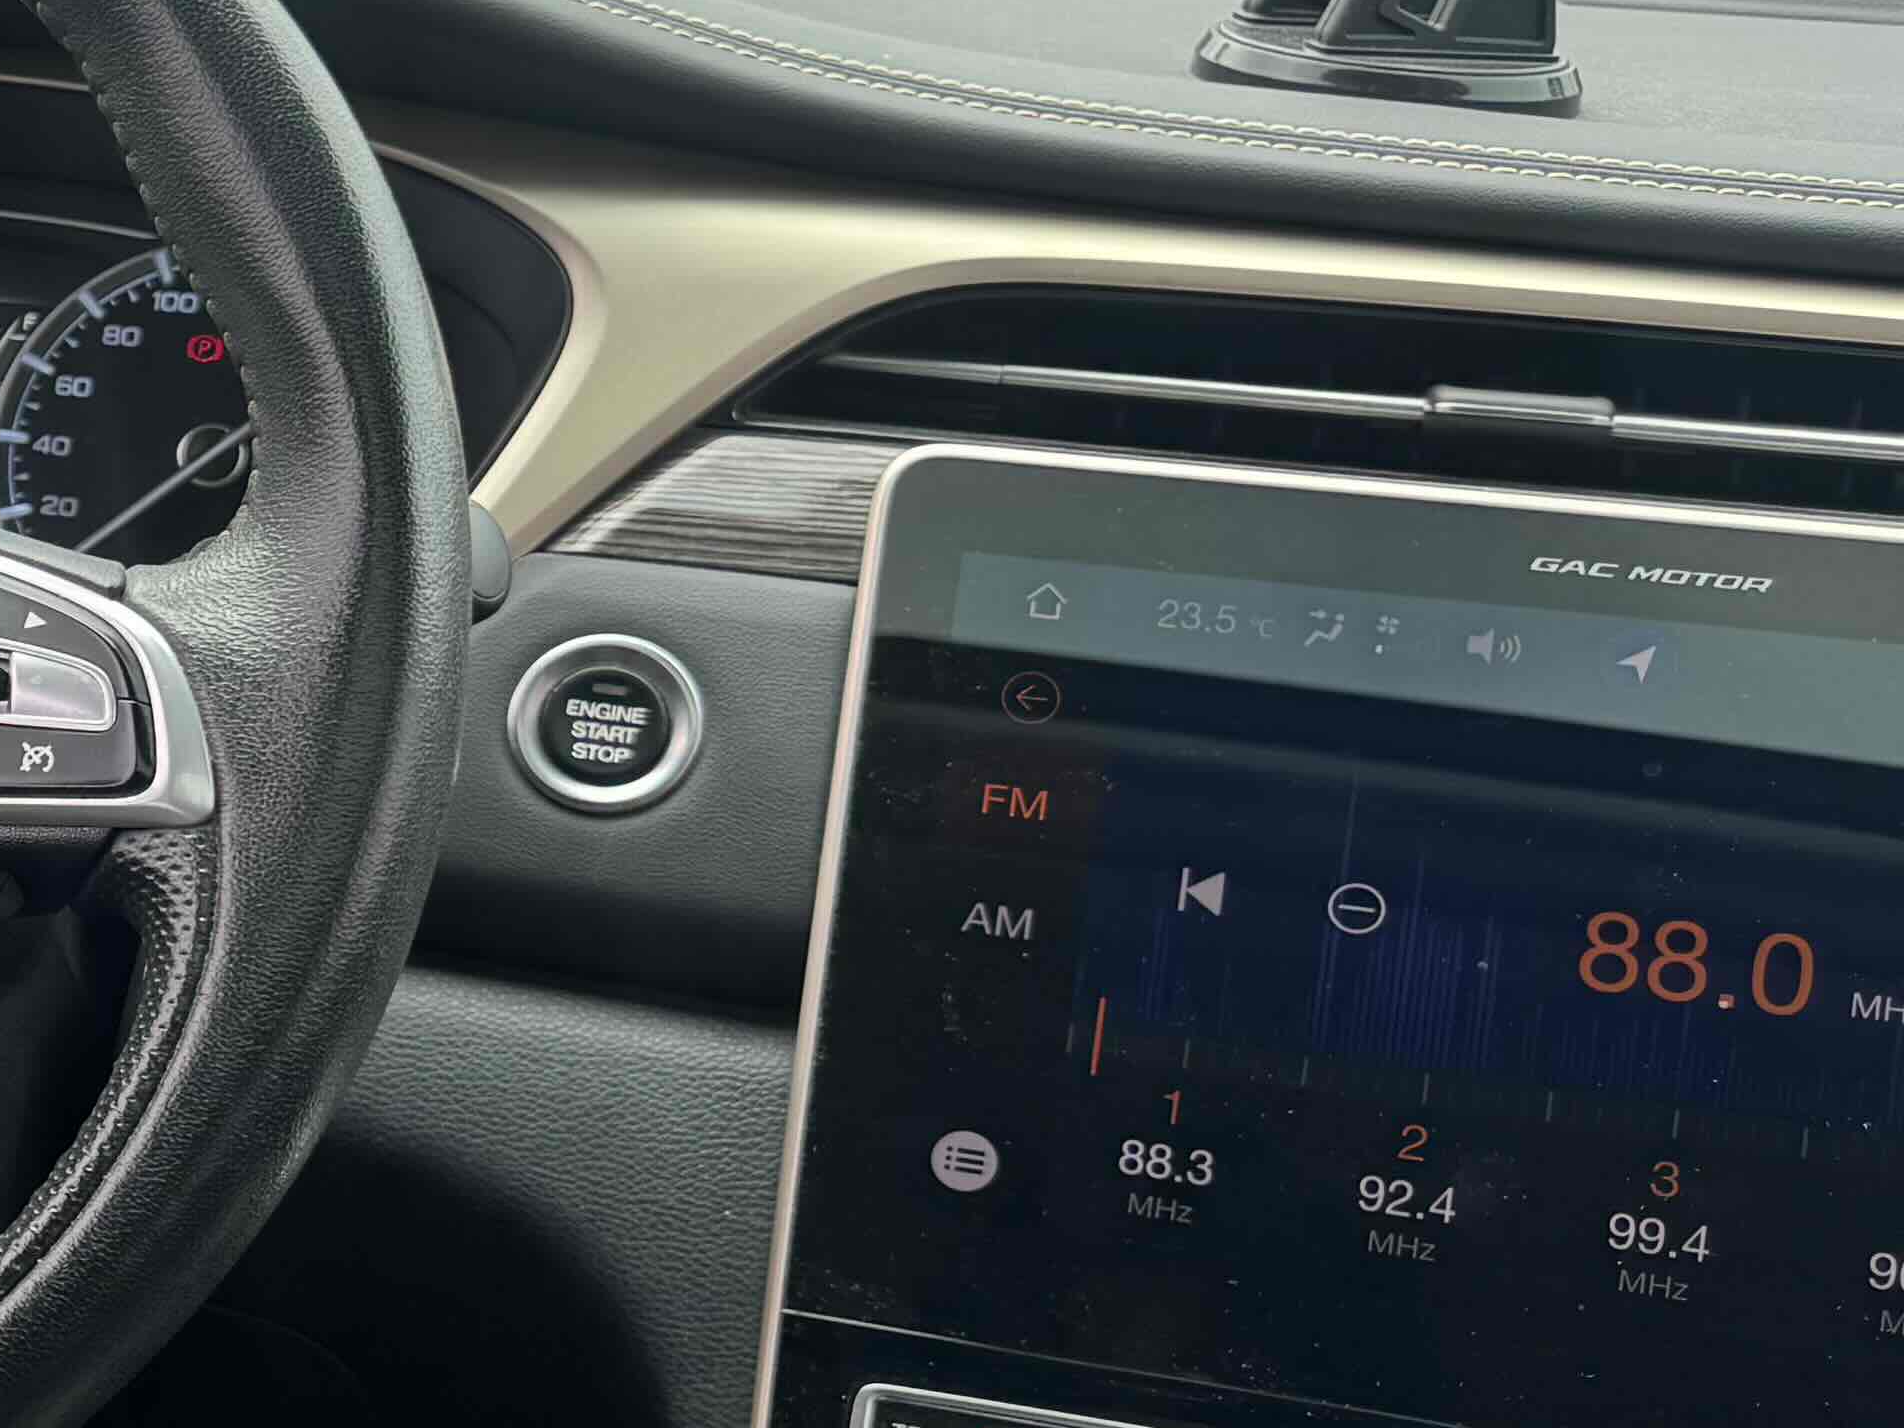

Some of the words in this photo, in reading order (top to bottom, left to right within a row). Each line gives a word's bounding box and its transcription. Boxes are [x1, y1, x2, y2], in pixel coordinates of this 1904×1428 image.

[153, 291, 200, 314] 100
[102, 324, 143, 348] 80
[55, 375, 93, 398] 60
[32, 434, 72, 457] 40
[40, 494, 80, 518] 20
[1528, 556, 1620, 580] GAC
[1627, 564, 1775, 594] MOTOR
[1156, 599, 1239, 635] 23.5
[565, 698, 651, 726] ENGINE
[570, 720, 641, 745] START
[570, 741, 633, 764] STOP
[980, 783, 1050, 822] FM
[960, 901, 1036, 941] AM
[1578, 911, 1815, 1016] 88.0
[1162, 1090, 1181, 1125] 1
[1396, 1124, 1429, 1162] 2
[1118, 1138, 1216, 1186] 88.3
[1650, 1161, 1681, 1198] 3
[1127, 1193, 1194, 1224] MHz
[1357, 1174, 1457, 1225] 92.4
[1367, 1229, 1437, 1262] MHz
[1607, 1212, 1710, 1263] 99.4
[1617, 1269, 1690, 1302] MHz
